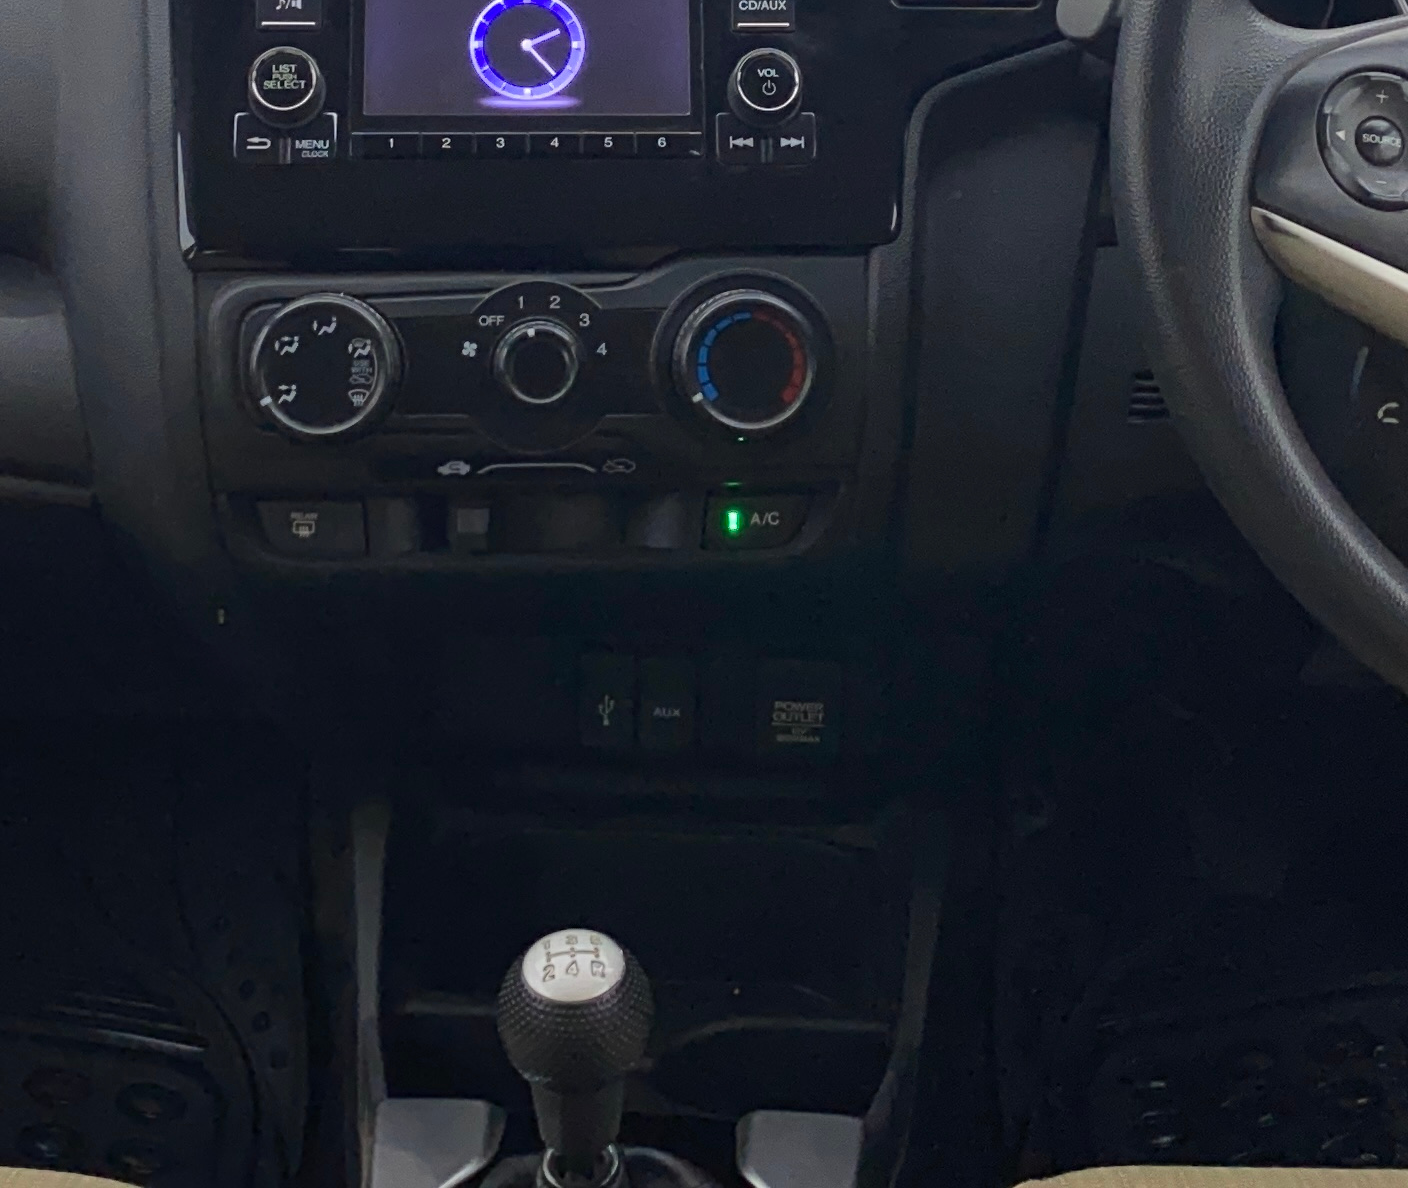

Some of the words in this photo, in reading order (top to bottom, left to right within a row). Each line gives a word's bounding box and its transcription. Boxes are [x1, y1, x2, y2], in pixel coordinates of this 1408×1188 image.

[738, 0, 787, 11] CD/AUX
[272, 64, 297, 73] LIST
[757, 68, 779, 78] VOL
[263, 80, 306, 90] SELECT
[295, 139, 330, 150] MENU
[388, 138, 394, 148] 1
[442, 137, 451, 149] 2
[496, 137, 505, 149] 3
[550, 137, 560, 149] 4
[604, 137, 613, 149] 5
[657, 137, 667, 149] 6
[301, 150, 329, 158] CLOCK
[517, 296, 524, 309] 1
[550, 296, 561, 309] 2
[478, 315, 505, 327] OFF
[579, 313, 590, 326] 3
[596, 342, 608, 355] 4
[750, 512, 780, 525] A/C
[652, 707, 681, 717] AUX
[543, 964, 555, 982] 2
